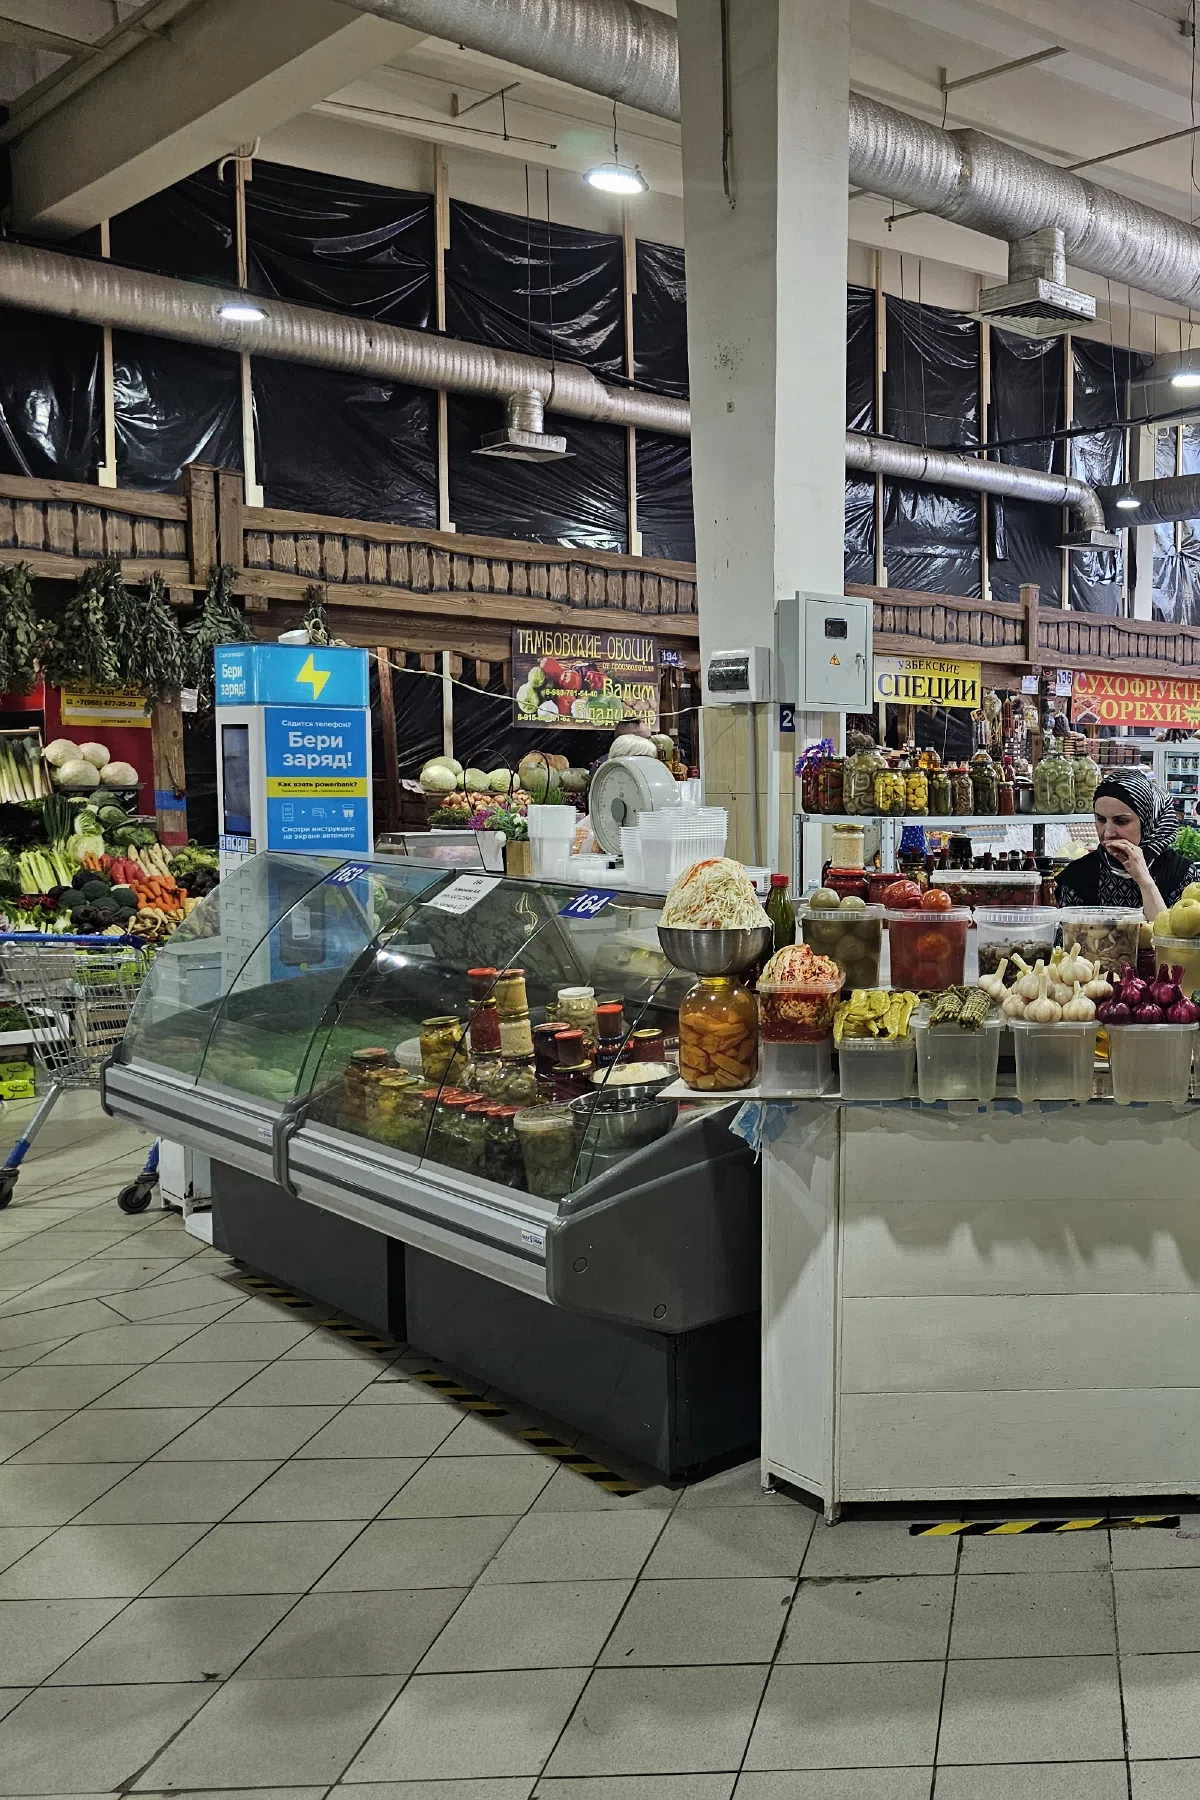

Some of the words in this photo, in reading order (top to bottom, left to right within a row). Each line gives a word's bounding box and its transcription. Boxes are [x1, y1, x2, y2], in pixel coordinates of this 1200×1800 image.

[517, 629, 602, 658] ТАМБОВСКИЕ
[607, 636, 654, 665] ОВОЩИ
[662, 651, 678, 661] 194
[222, 663, 243, 680] Бери
[898, 660, 960, 674] УЗБЕКСКИЕ
[221, 680, 247, 698] заряд!
[603, 678, 655, 702] Вадим
[877, 673, 978, 706] СПЕЦИИ
[782, 710, 796, 727] 2
[1100, 699, 1182, 723] ОРЕХИ
[281, 719, 313, 727] Садится
[315, 721, 352, 729] телефон?
[288, 731, 343, 751] Бери
[282, 752, 352, 770] заряд!
[332, 866, 364, 882] 163
[568, 893, 610, 914] 164
